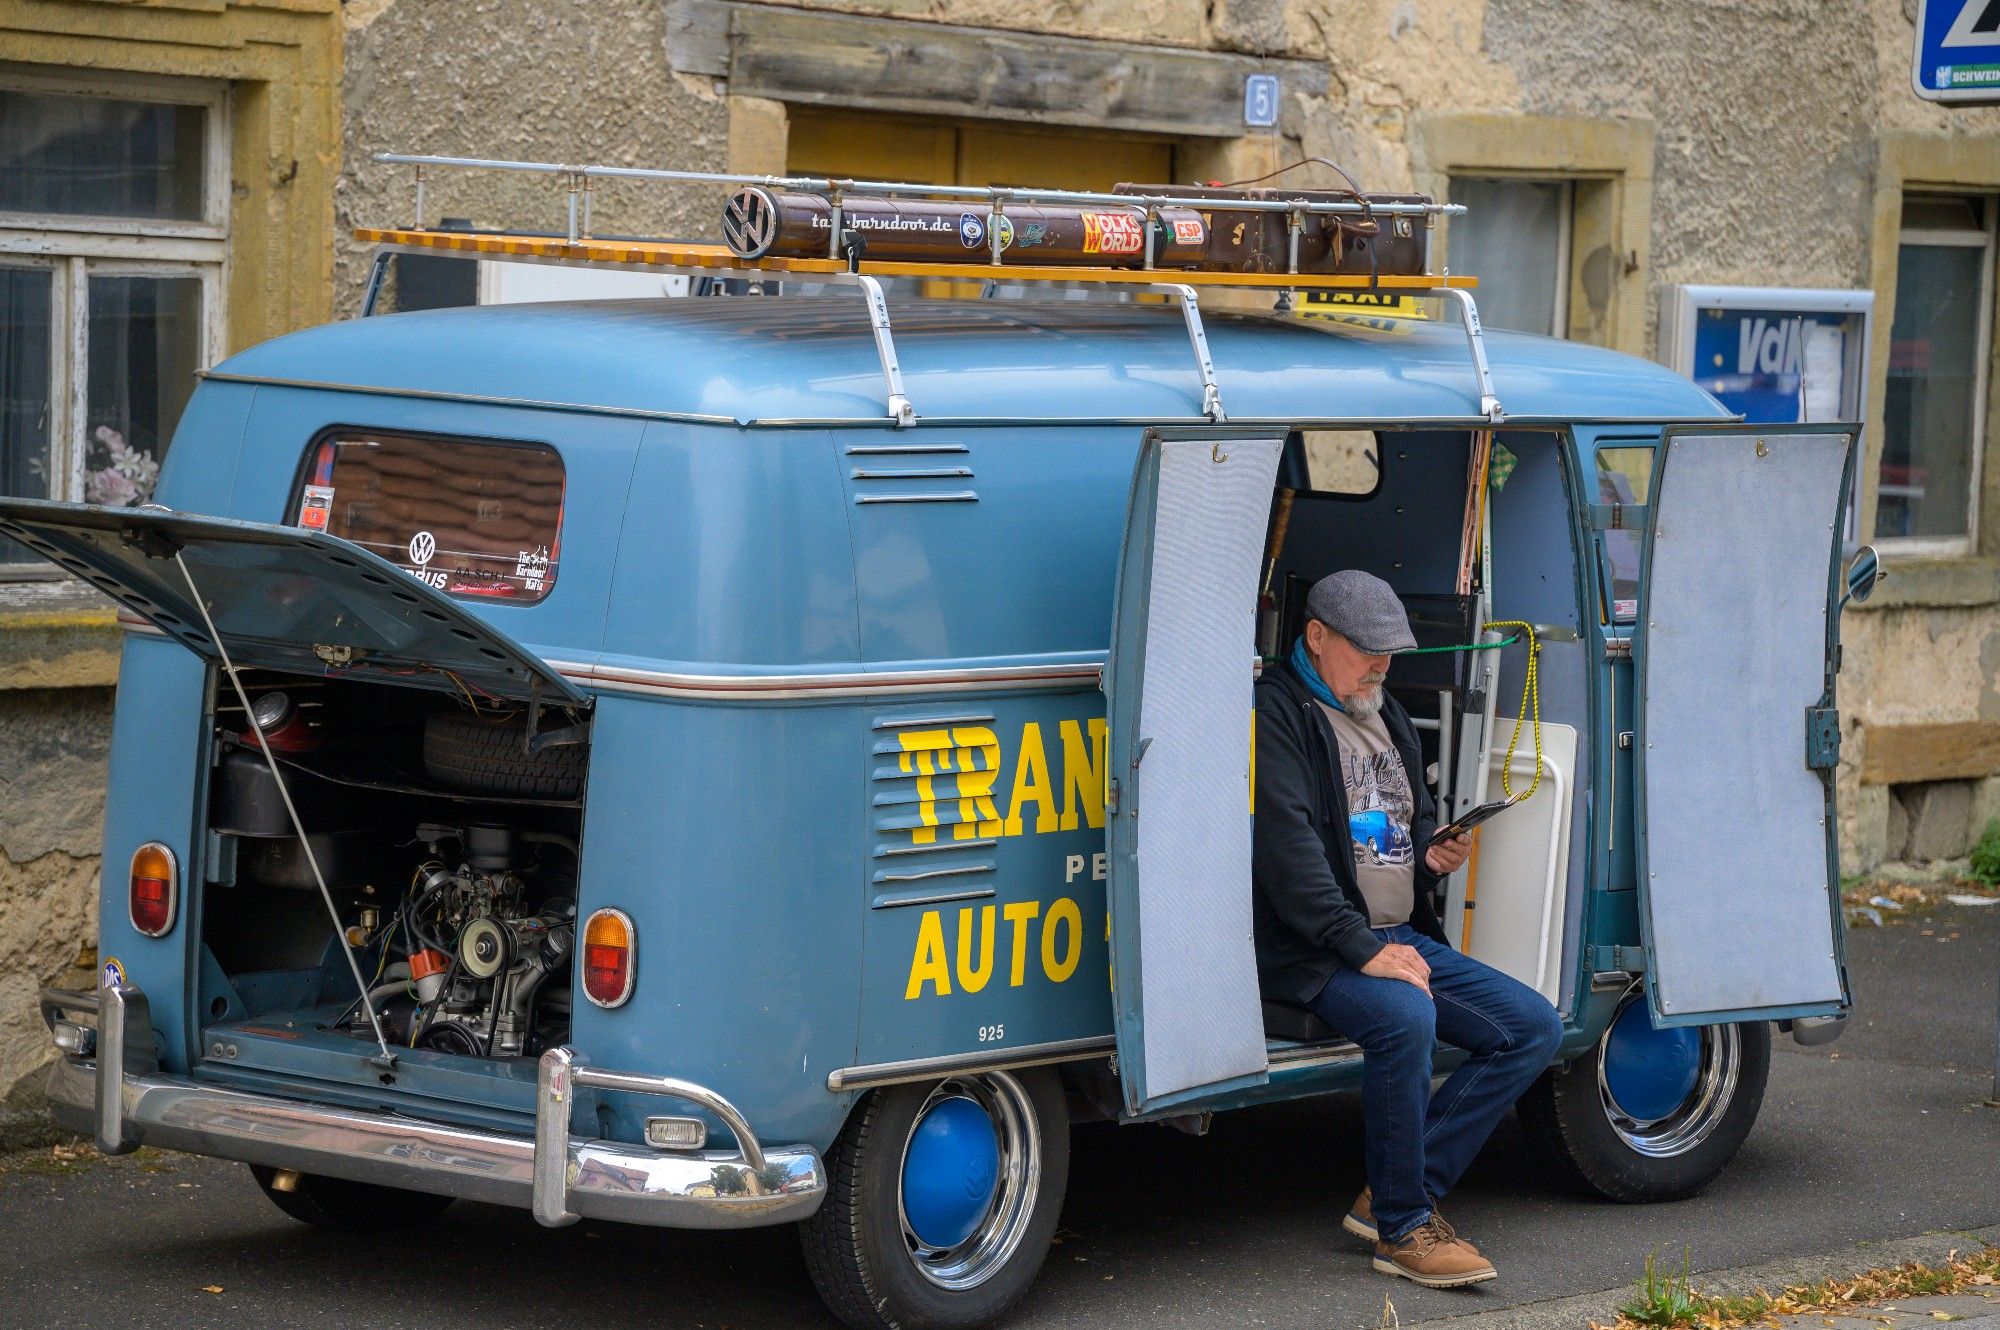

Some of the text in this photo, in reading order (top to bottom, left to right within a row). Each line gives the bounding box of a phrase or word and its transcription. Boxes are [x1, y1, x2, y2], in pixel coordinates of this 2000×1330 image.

[1256, 84, 1269, 117] 5
[811, 213, 953, 232] ta-barndoor.de
[1177, 223, 1201, 237] CSP
[1083, 232, 1142, 253] WORLD
[1738, 318, 1818, 375] VdK
[404, 569, 448, 590] BUS
[898, 717, 1107, 845] TRAN
[904, 897, 1083, 1000] AUTO
[979, 1023, 1004, 1042] 925
